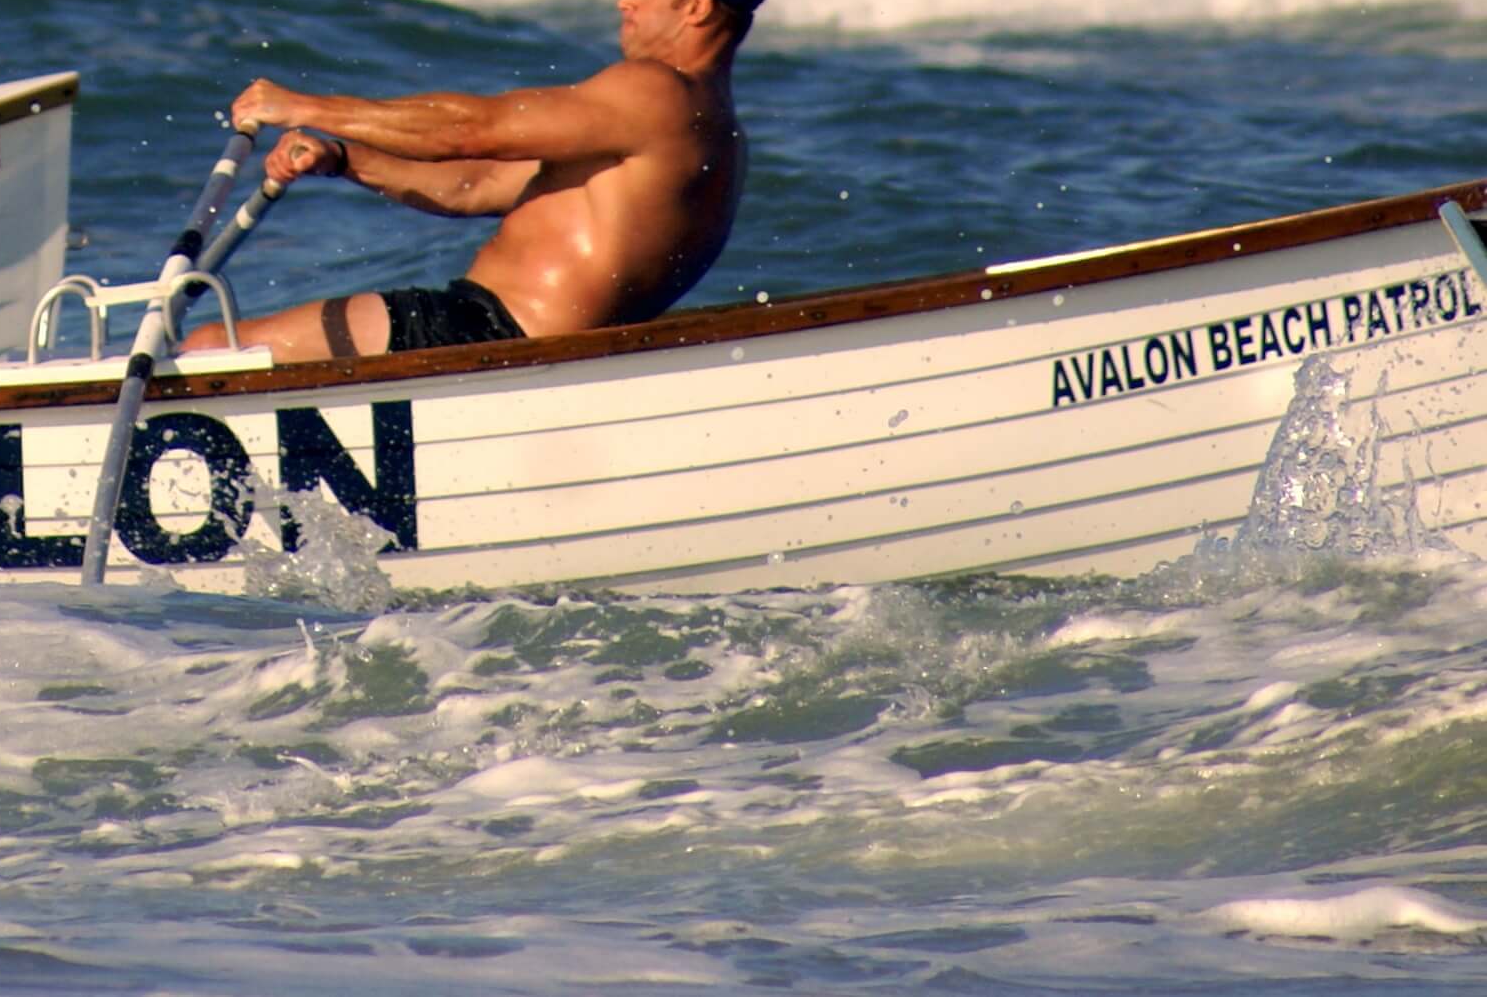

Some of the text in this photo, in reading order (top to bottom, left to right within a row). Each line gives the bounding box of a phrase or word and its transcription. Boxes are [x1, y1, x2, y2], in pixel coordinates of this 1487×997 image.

[1052, 270, 1482, 407] AVALON BEACH PATROL
